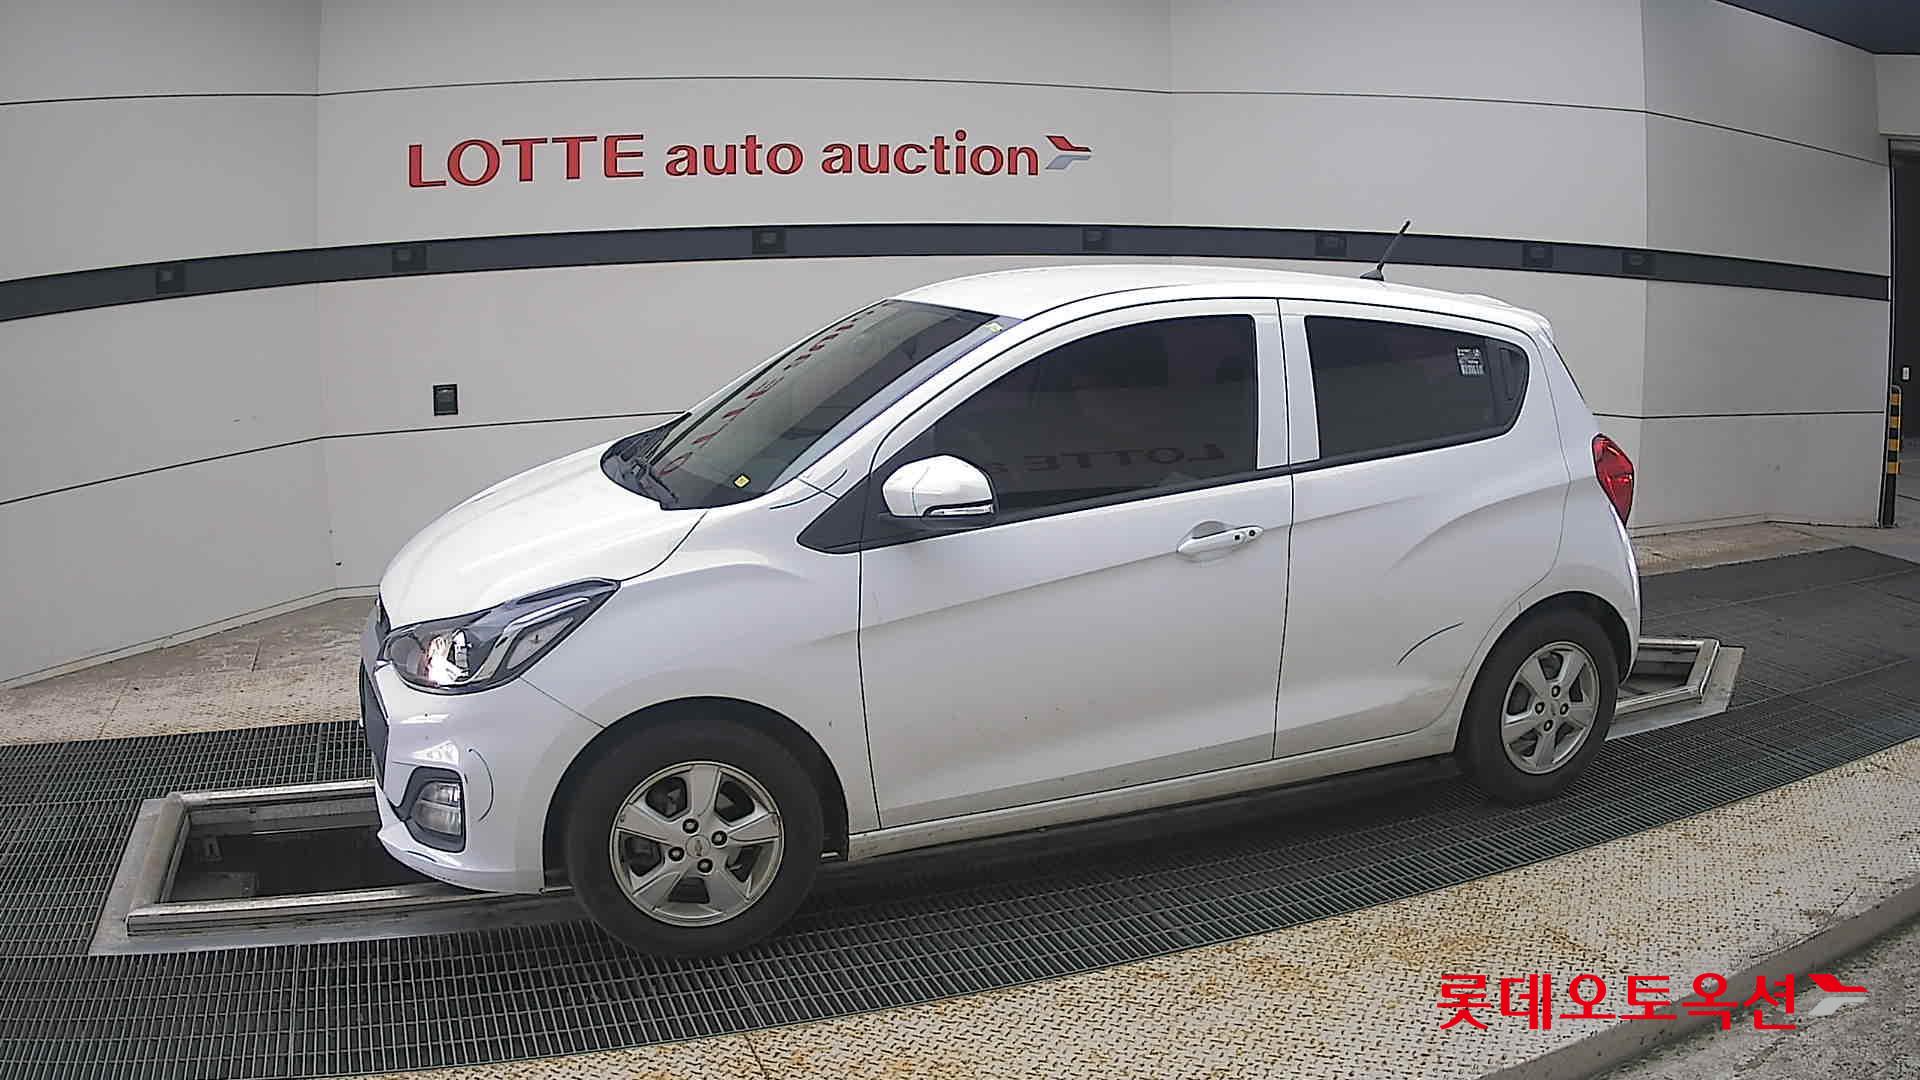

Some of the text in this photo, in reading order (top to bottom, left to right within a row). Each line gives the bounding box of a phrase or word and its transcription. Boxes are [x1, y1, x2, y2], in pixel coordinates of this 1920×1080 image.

[408, 129, 1040, 188] LOTTE auto auction
